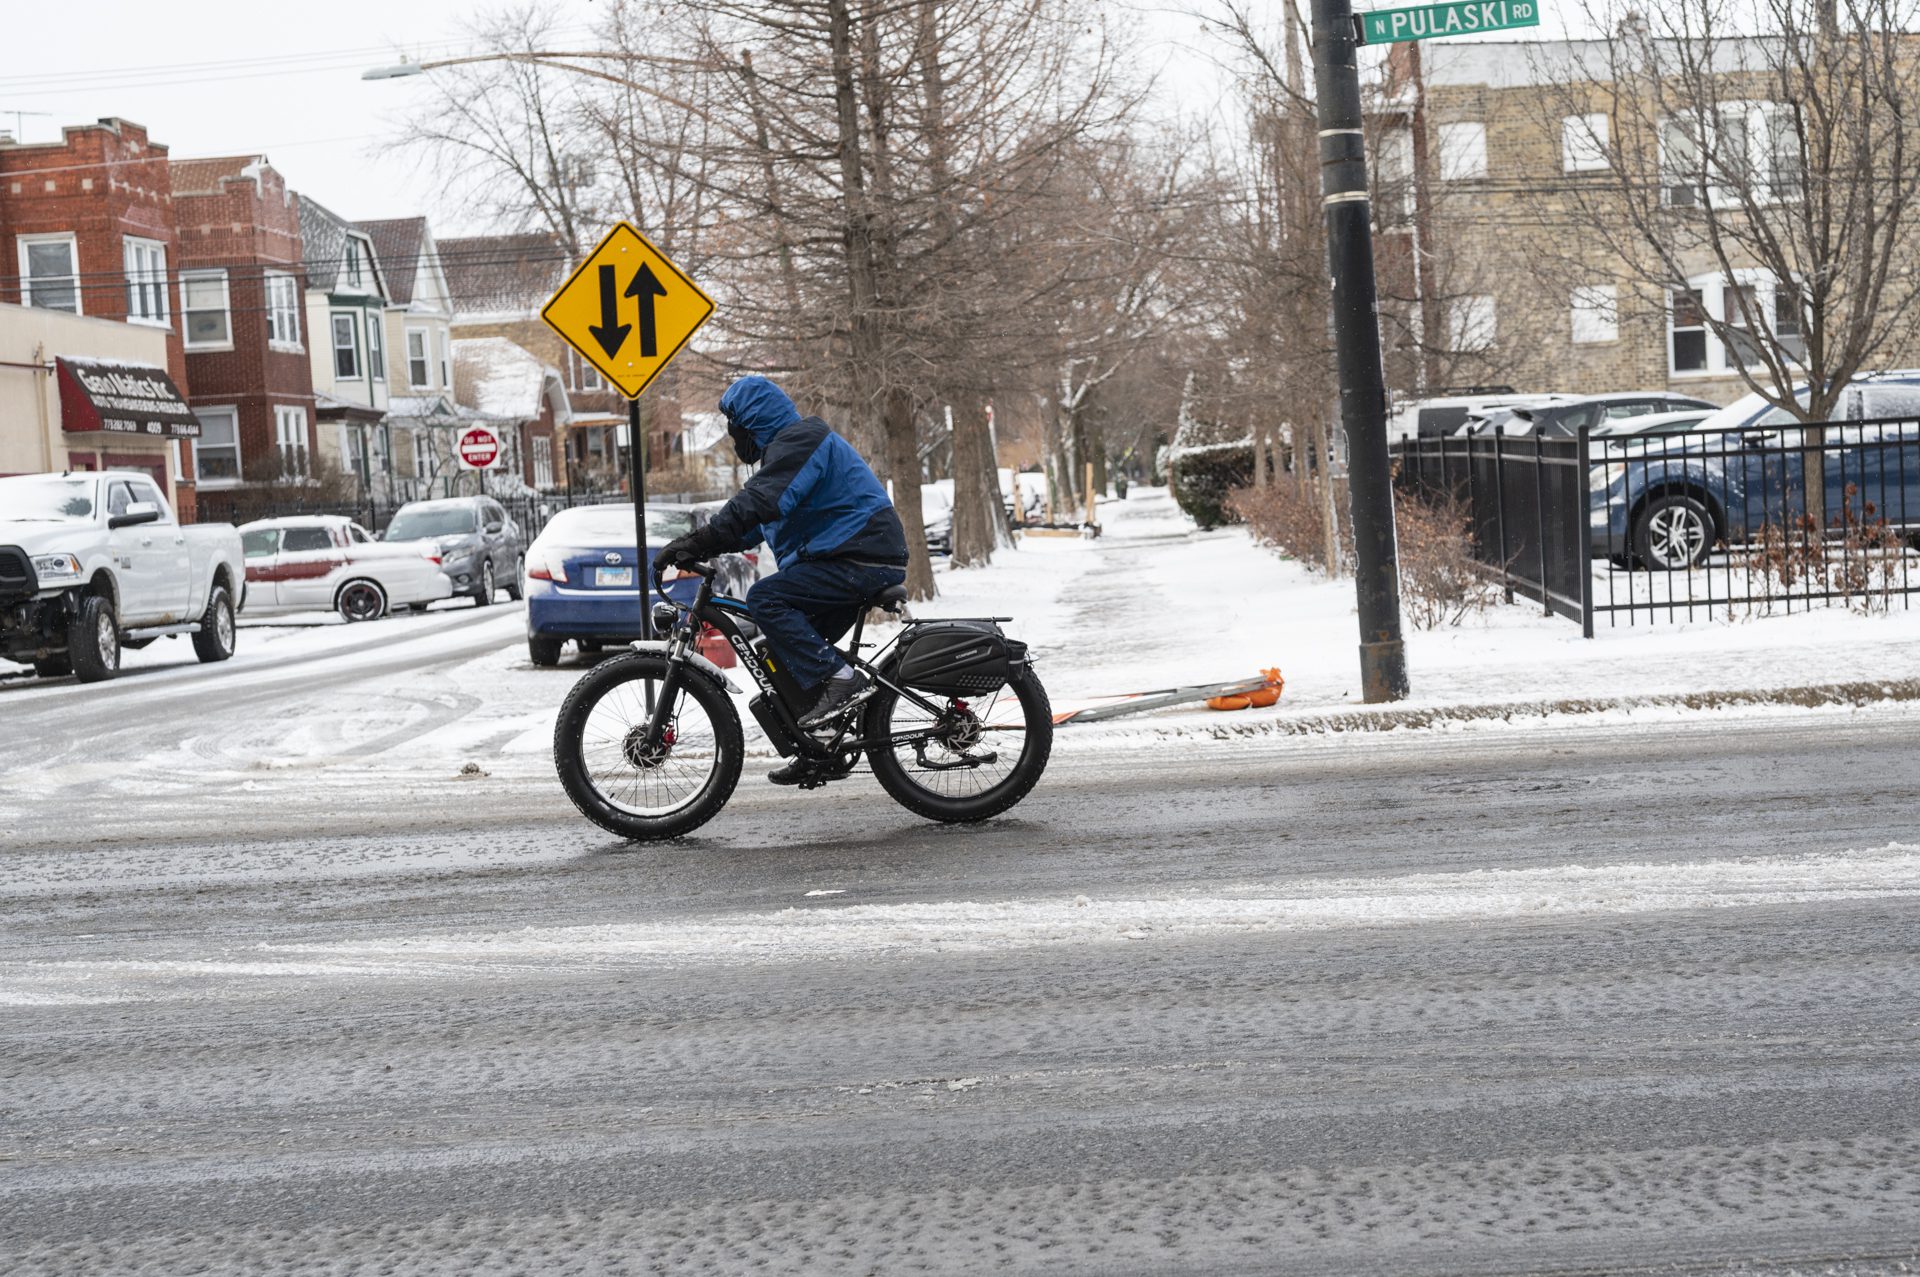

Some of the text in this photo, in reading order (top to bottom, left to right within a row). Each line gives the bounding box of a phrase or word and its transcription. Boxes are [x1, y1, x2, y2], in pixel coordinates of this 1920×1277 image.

[1375, 0, 1533, 38] N PULASKI RD
[463, 435, 492, 445] DO NOT
[467, 453, 491, 461] ENTER
